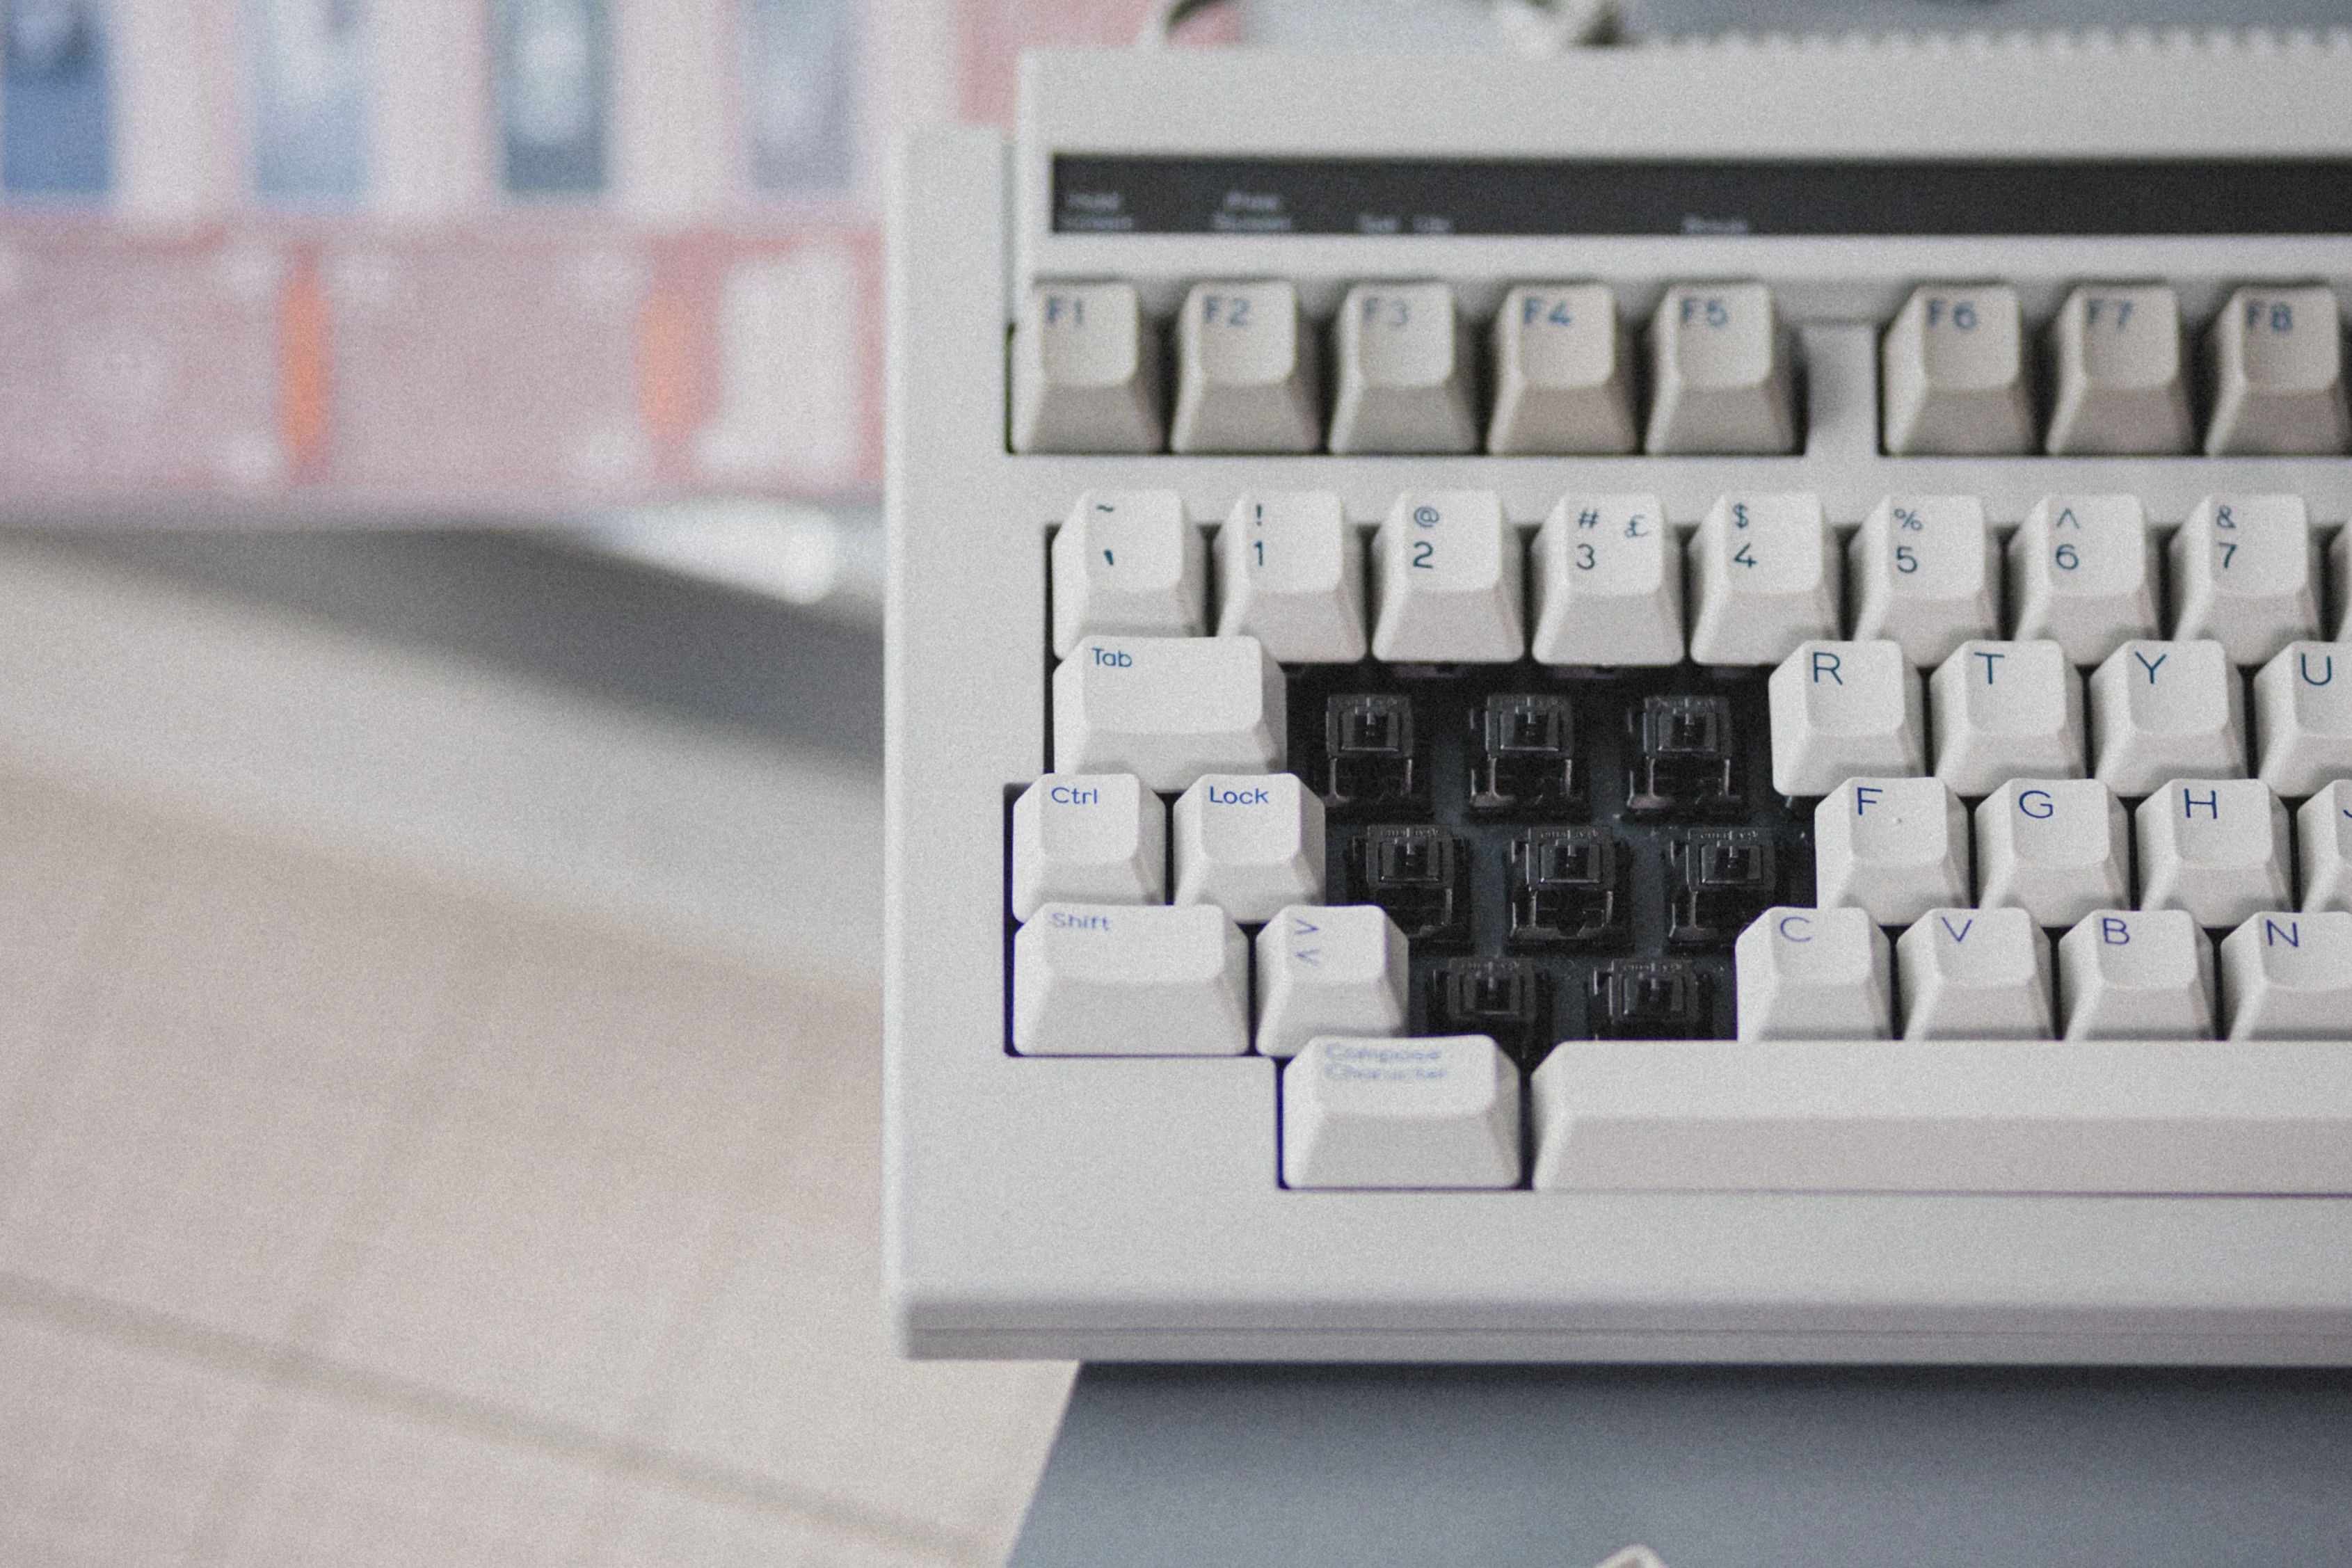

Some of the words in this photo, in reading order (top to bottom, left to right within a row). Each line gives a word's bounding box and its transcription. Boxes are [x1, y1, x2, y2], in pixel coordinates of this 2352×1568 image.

[1045, 295, 1083, 327] F1
[1203, 295, 1250, 328] F2
[1362, 296, 1409, 328] F3
[1522, 296, 1572, 327] F4
[1679, 296, 1729, 328] F5
[1255, 504, 1263, 527] !
[1413, 506, 1440, 528] @
[1577, 509, 1599, 529] #
[1624, 514, 1651, 539] £
[1732, 503, 1749, 529] $
[1893, 508, 1923, 531] %
[2216, 506, 2236, 530] &
[1254, 540, 1263, 566] 1
[1412, 541, 1434, 569] 2
[1576, 543, 1597, 570] 3
[1733, 543, 1757, 568] 4
[1896, 546, 1918, 574] 5
[2054, 543, 2079, 571] 6
[2218, 542, 2237, 569] 7
[1091, 647, 1133, 669] Tab
[1812, 650, 1843, 686] R
[1974, 651, 2005, 685] T
[2134, 651, 2167, 685] Y
[2300, 653, 2333, 687] U
[1050, 786, 1098, 805] Ctrl
[1208, 785, 1270, 806] Lock
[1857, 786, 1883, 816] F
[2018, 789, 2054, 819] G
[2183, 787, 2218, 819] H
[1052, 912, 1111, 931] Shift
[1295, 918, 1319, 936] >
[1779, 916, 1811, 943] C
[1942, 916, 1973, 943] V
[2102, 918, 2131, 945] B
[2266, 919, 2300, 948] N
[1295, 948, 1320, 966] <
